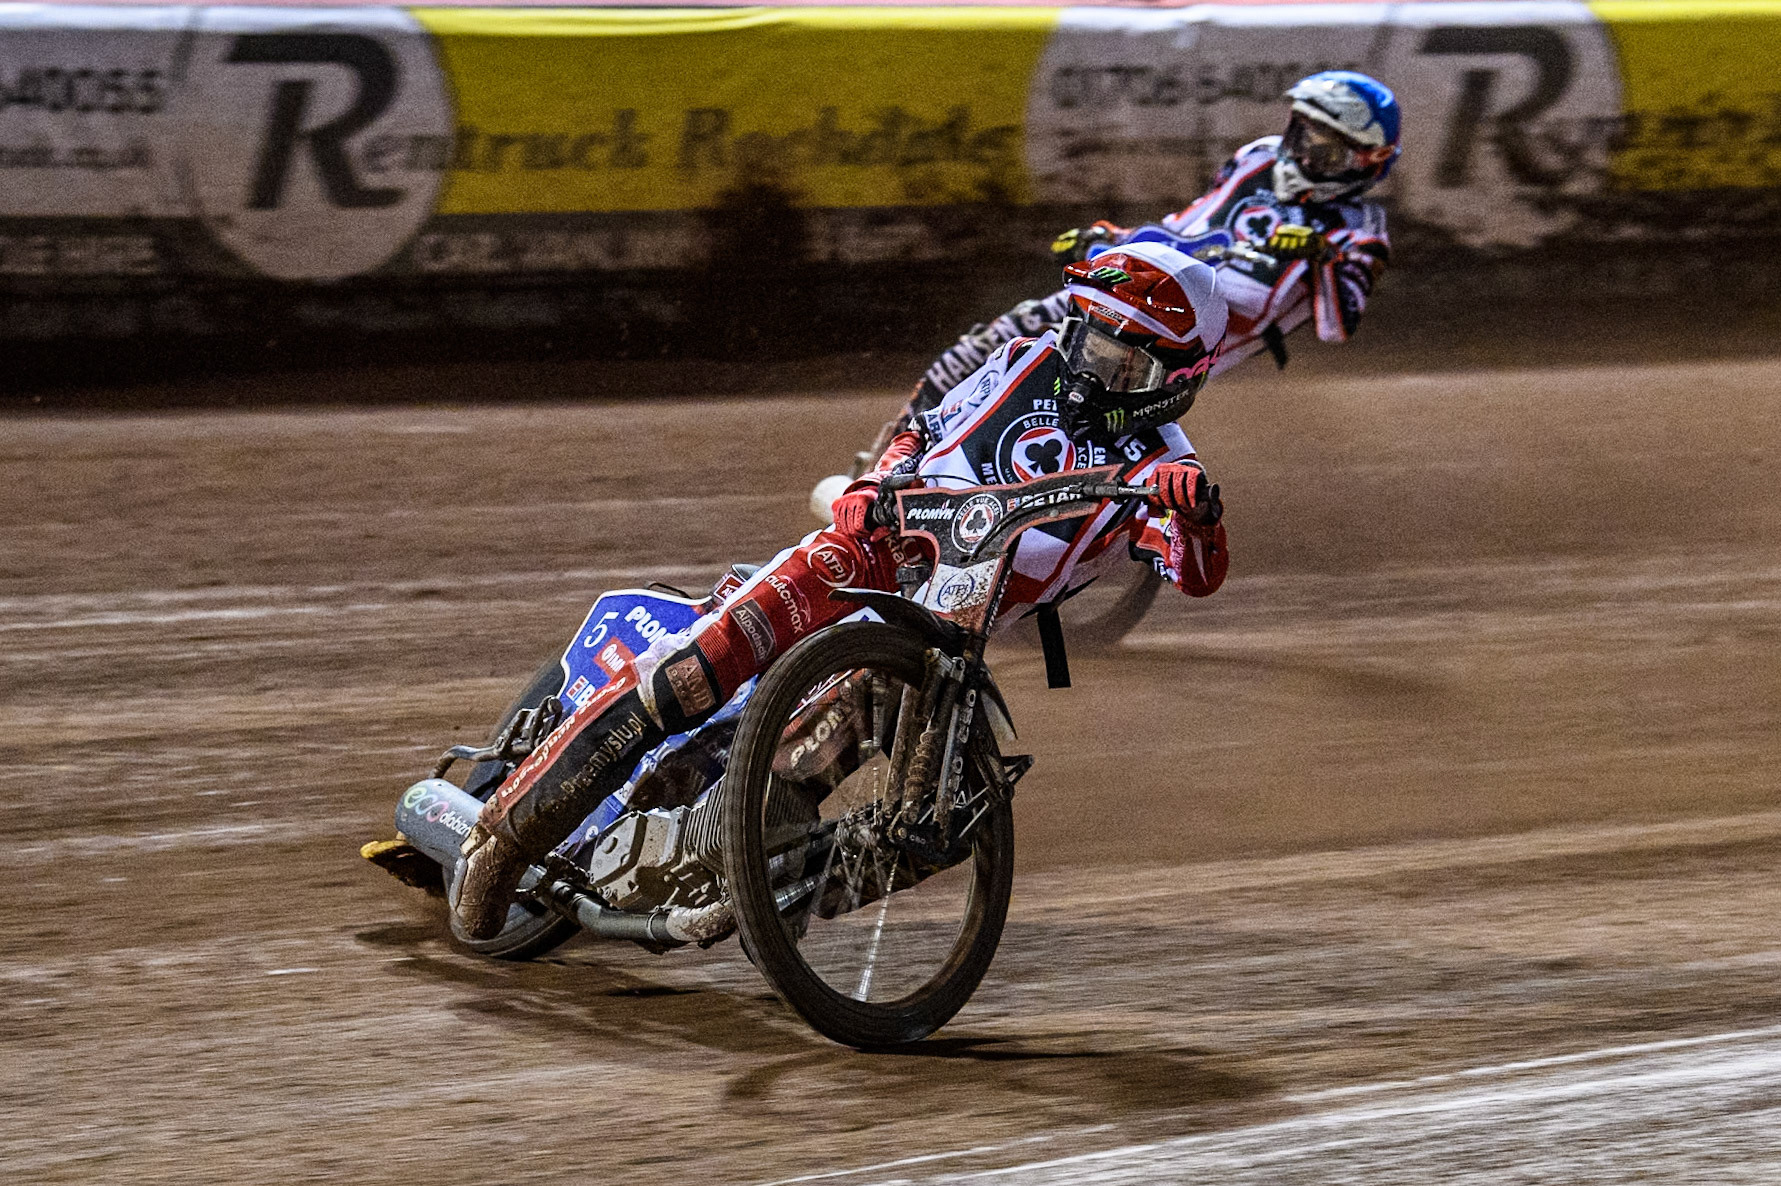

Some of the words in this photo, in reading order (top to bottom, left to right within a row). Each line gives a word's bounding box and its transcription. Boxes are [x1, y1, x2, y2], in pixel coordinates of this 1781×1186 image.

[1023, 418, 1060, 429] BELLE
[817, 550, 846, 580] ATPI
[584, 612, 620, 648] 5
